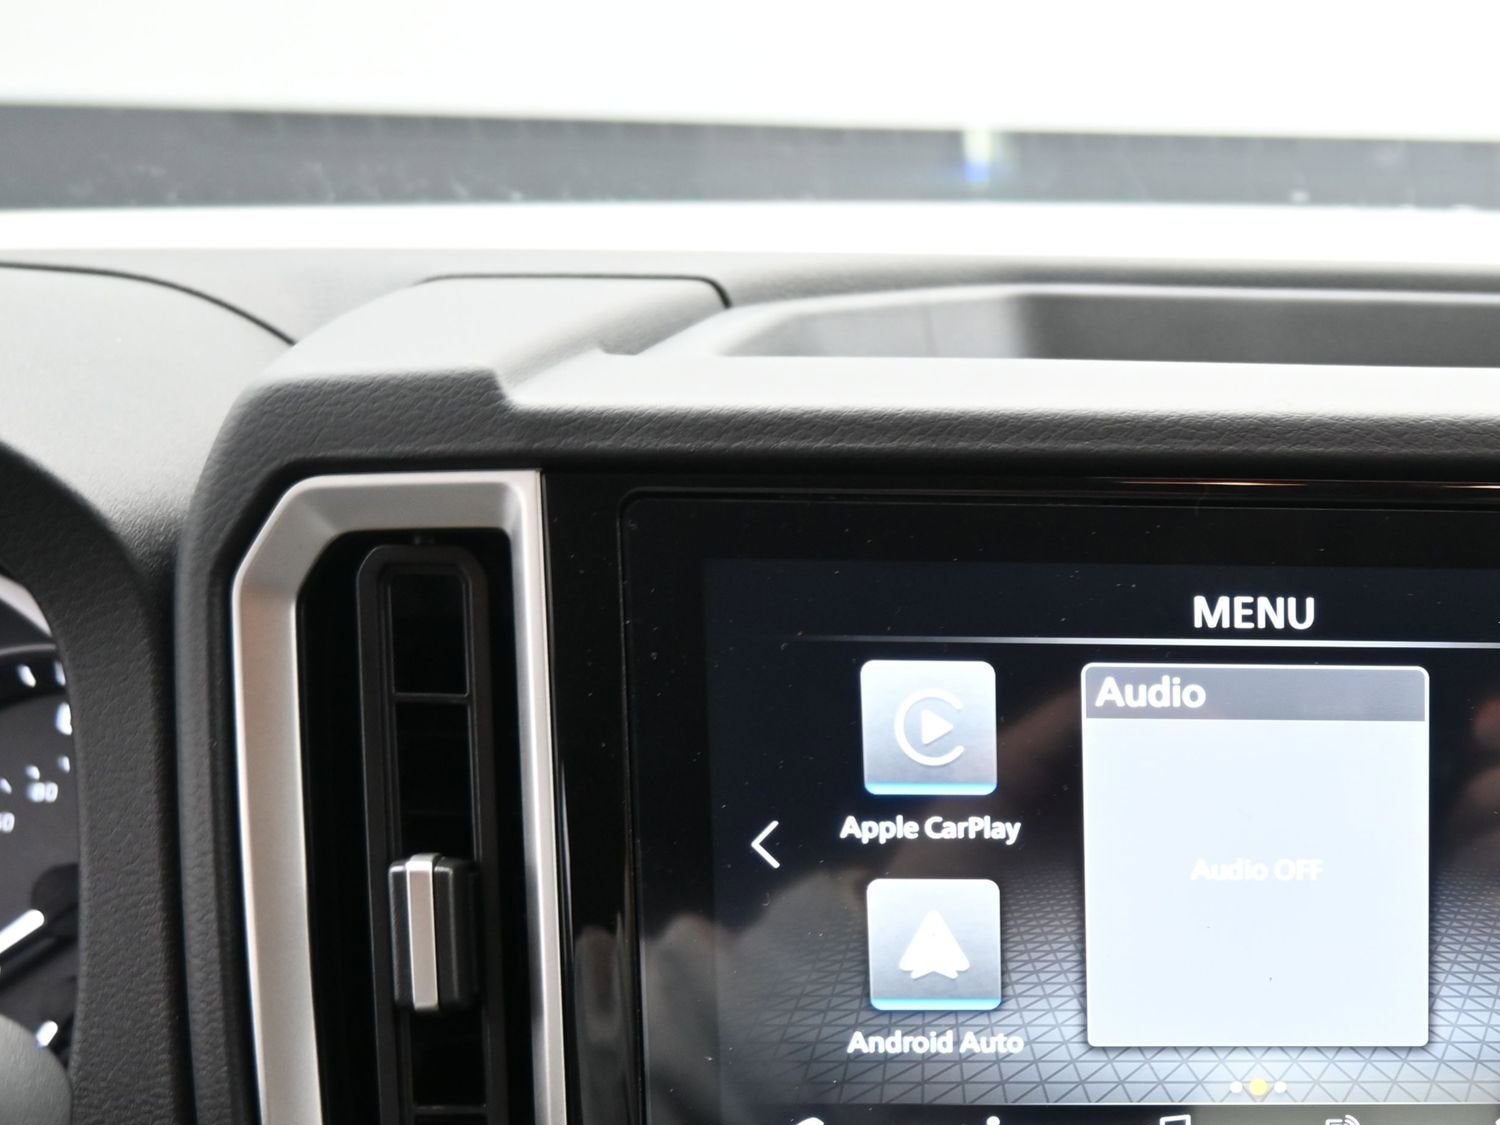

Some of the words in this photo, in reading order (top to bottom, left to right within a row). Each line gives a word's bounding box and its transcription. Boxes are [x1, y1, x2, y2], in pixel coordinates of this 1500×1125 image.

[1192, 595, 1317, 630] MENU
[1094, 676, 1207, 709] Audio
[839, 815, 919, 844] Apple
[923, 815, 1022, 845] CarPlay
[1190, 857, 1269, 882] Audio
[1273, 857, 1327, 882] OFF
[846, 1030, 955, 1055] Android
[958, 1030, 1026, 1055] Auto
